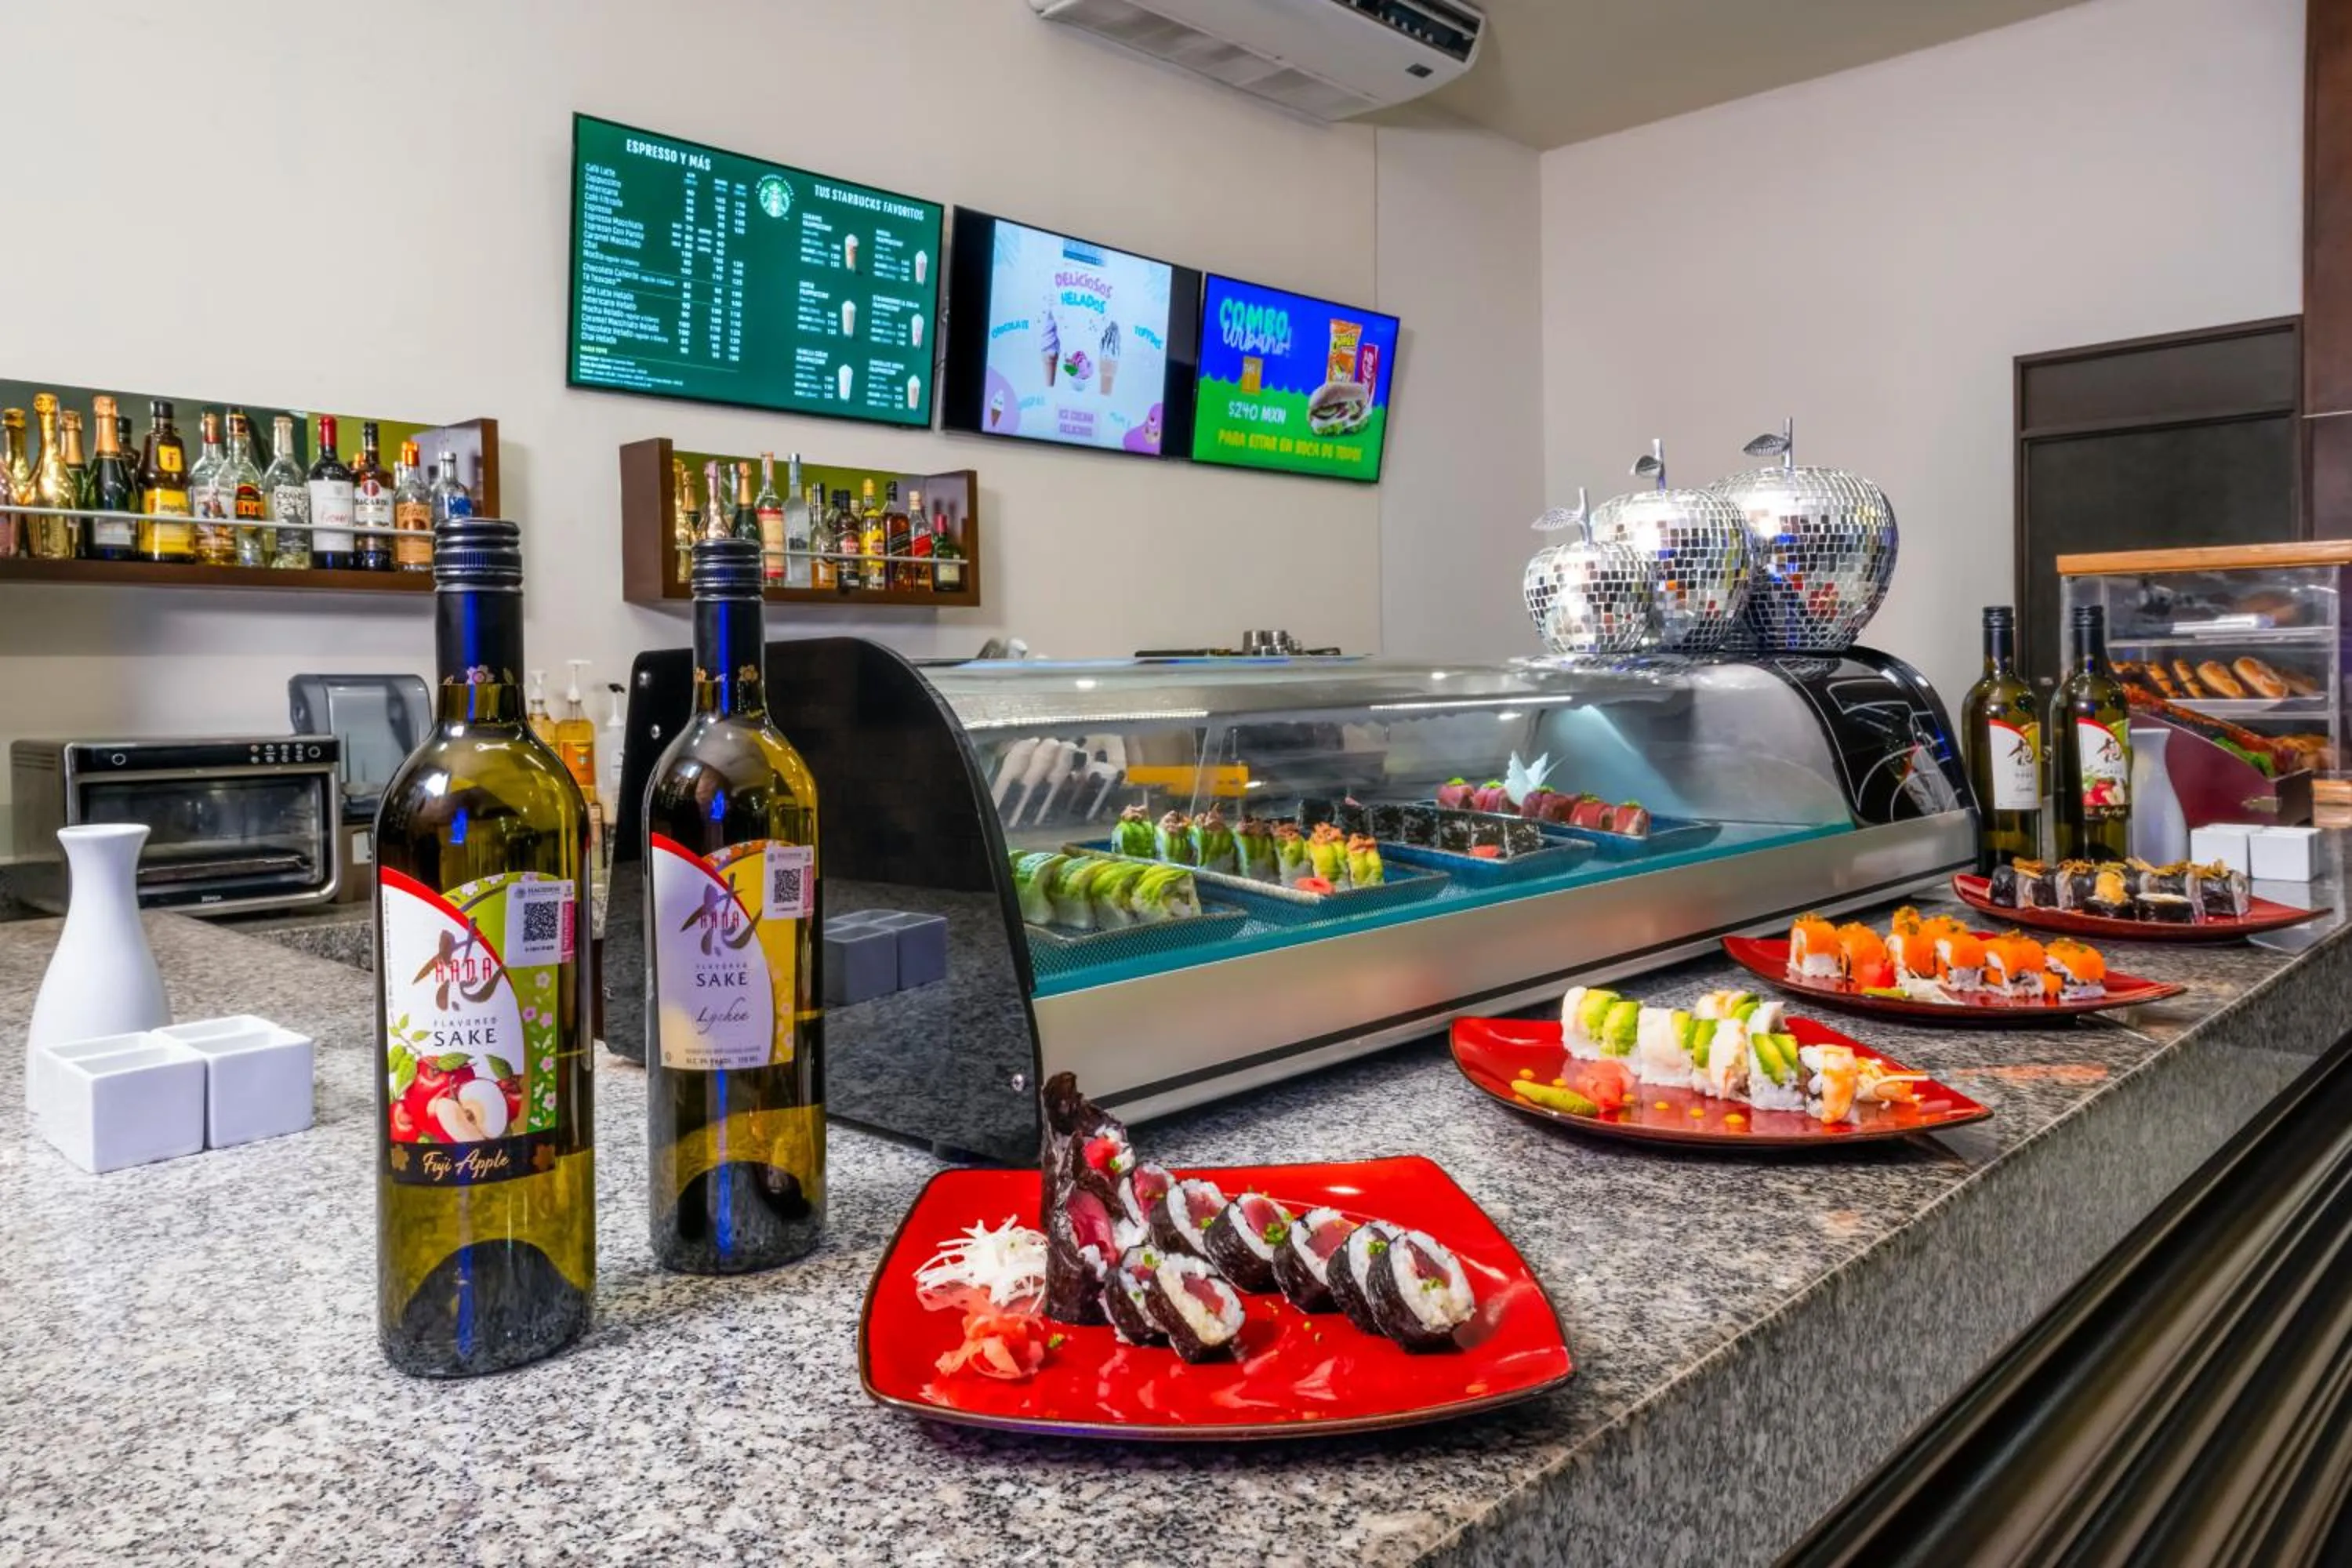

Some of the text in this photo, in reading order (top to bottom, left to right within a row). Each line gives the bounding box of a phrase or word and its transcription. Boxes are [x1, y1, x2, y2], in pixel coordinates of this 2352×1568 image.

[626, 139, 711, 172] ESPRESSO Y MÁS
[815, 183, 925, 221] TUS STARBUCKS FAVORITOS
[1054, 270, 1114, 299] DELICIOSOS
[1061, 290, 1106, 314] HELADOS
[991, 319, 1029, 339] CHOCOLATE
[1220, 297, 1289, 342] COMBO
[1229, 401, 1287, 425] $240 MXN
[1218, 428, 1246, 447] PARA
[1248, 432, 1277, 452] ESTAR
[1279, 437, 1293, 453] EN
[1294, 439, 1319, 458] BOCA
[1320, 442, 1333, 459] DE
[355, 498, 390, 506] BACARDI
[700, 910, 739, 929] HANA
[434, 956, 493, 983] HANA
[696, 971, 748, 988] SAKE
[434, 1017, 498, 1028] FLAVORED
[695, 996, 750, 1036] Lychee
[434, 1028, 498, 1047] SAKE
[423, 1147, 510, 1182] Fuji Apple
